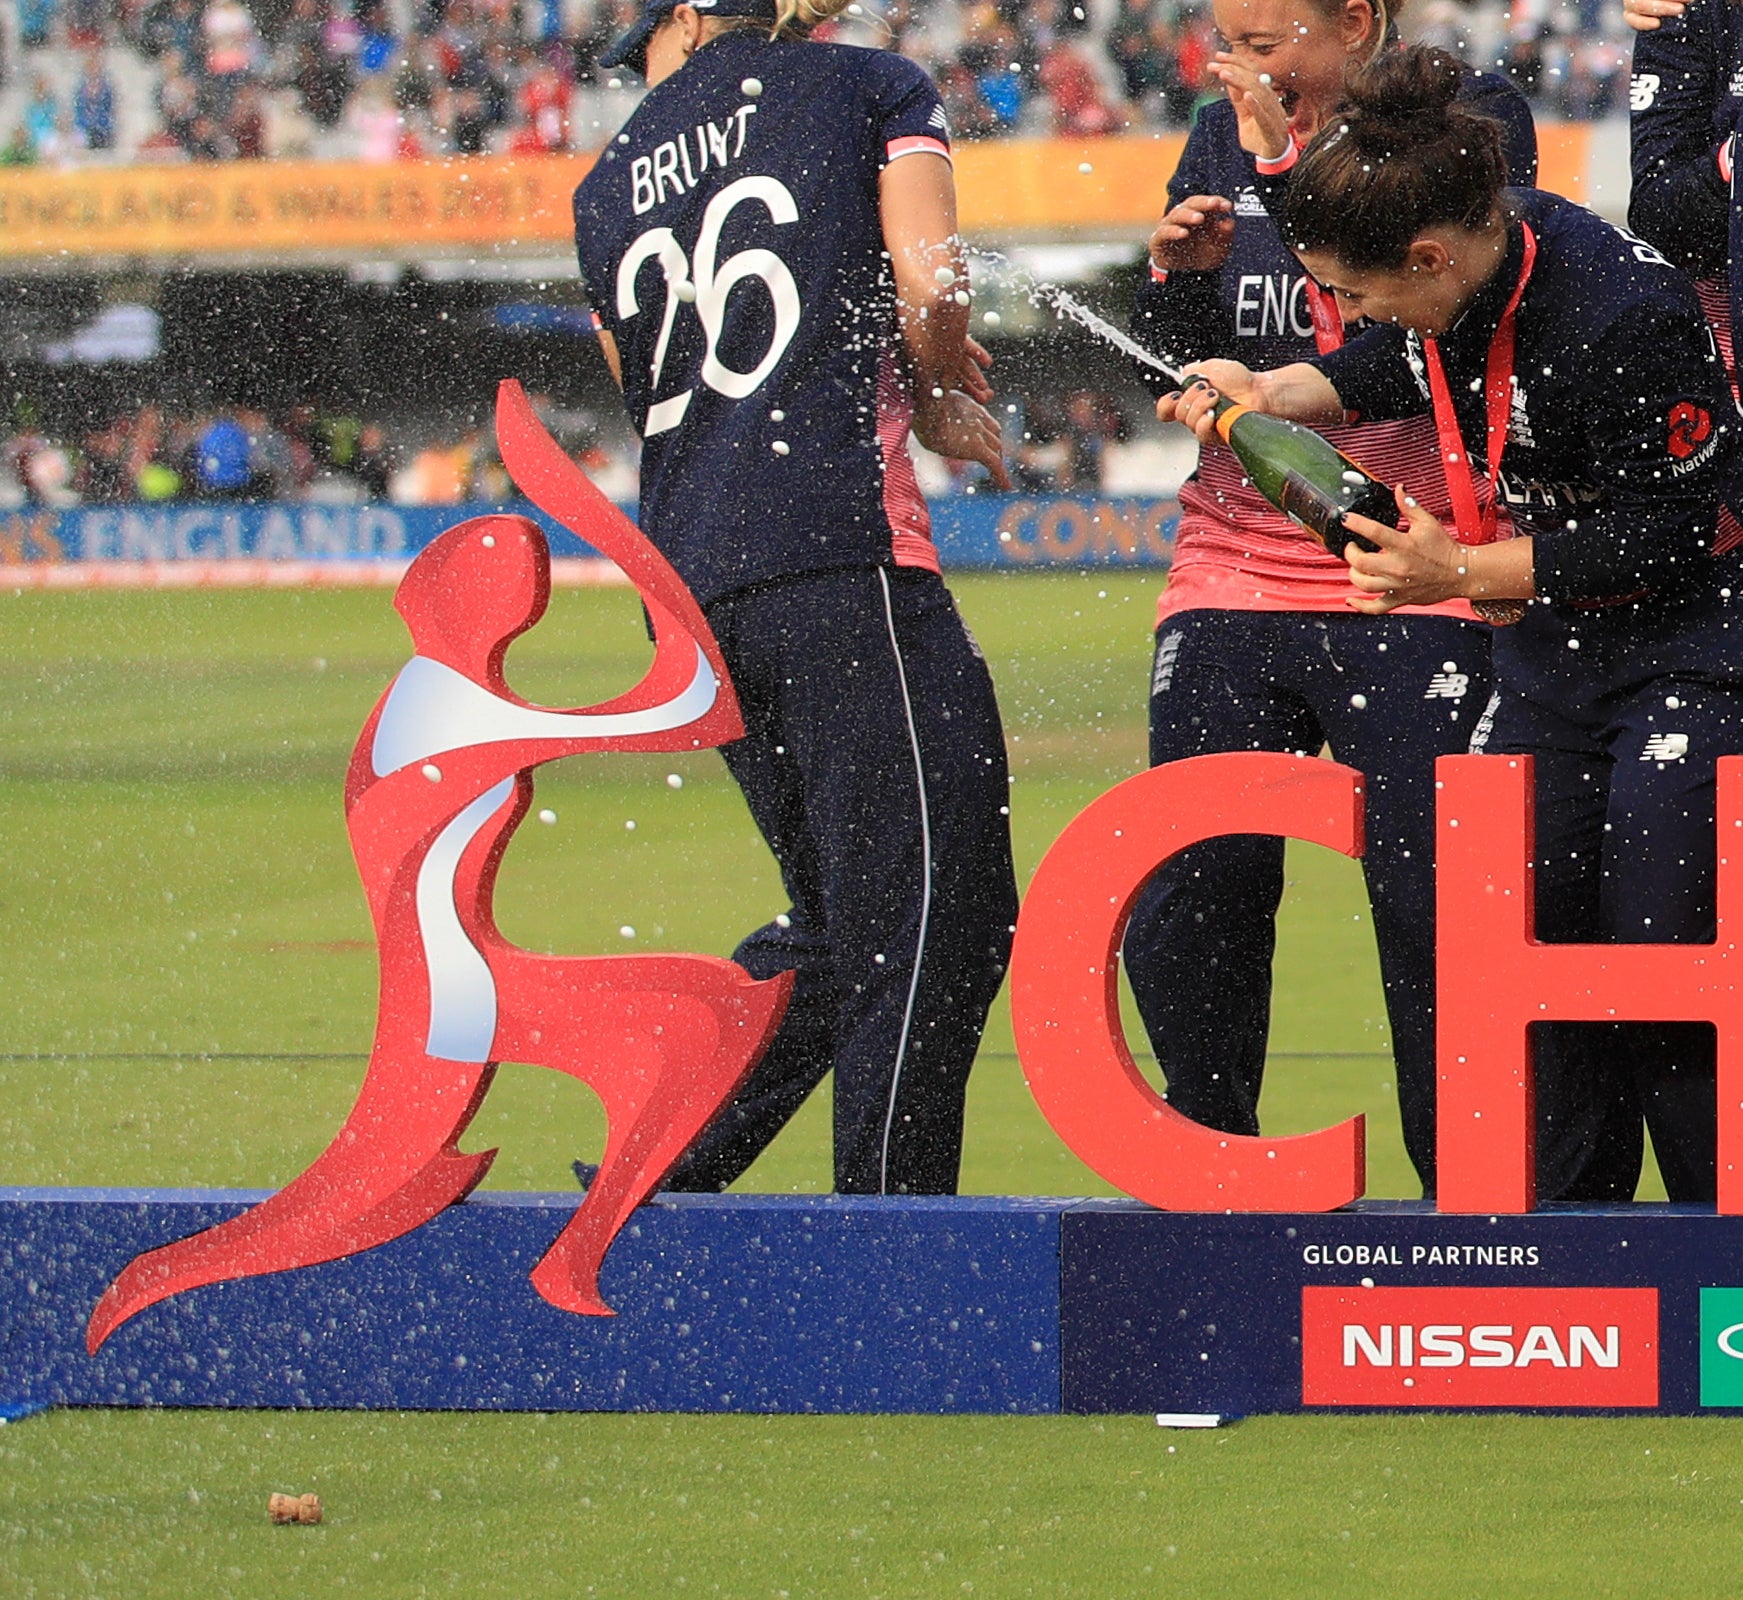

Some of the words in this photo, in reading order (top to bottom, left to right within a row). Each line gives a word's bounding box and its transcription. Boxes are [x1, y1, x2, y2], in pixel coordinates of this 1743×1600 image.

[631, 104, 757, 216] BRUNT
[617, 176, 800, 437] 26
[82, 510, 405, 561] ENGLAND
[1303, 1244, 1403, 1265] GLOBAL
[1412, 1245, 1539, 1266] PARTNERS
[1343, 1325, 1619, 1368] NISSAN
